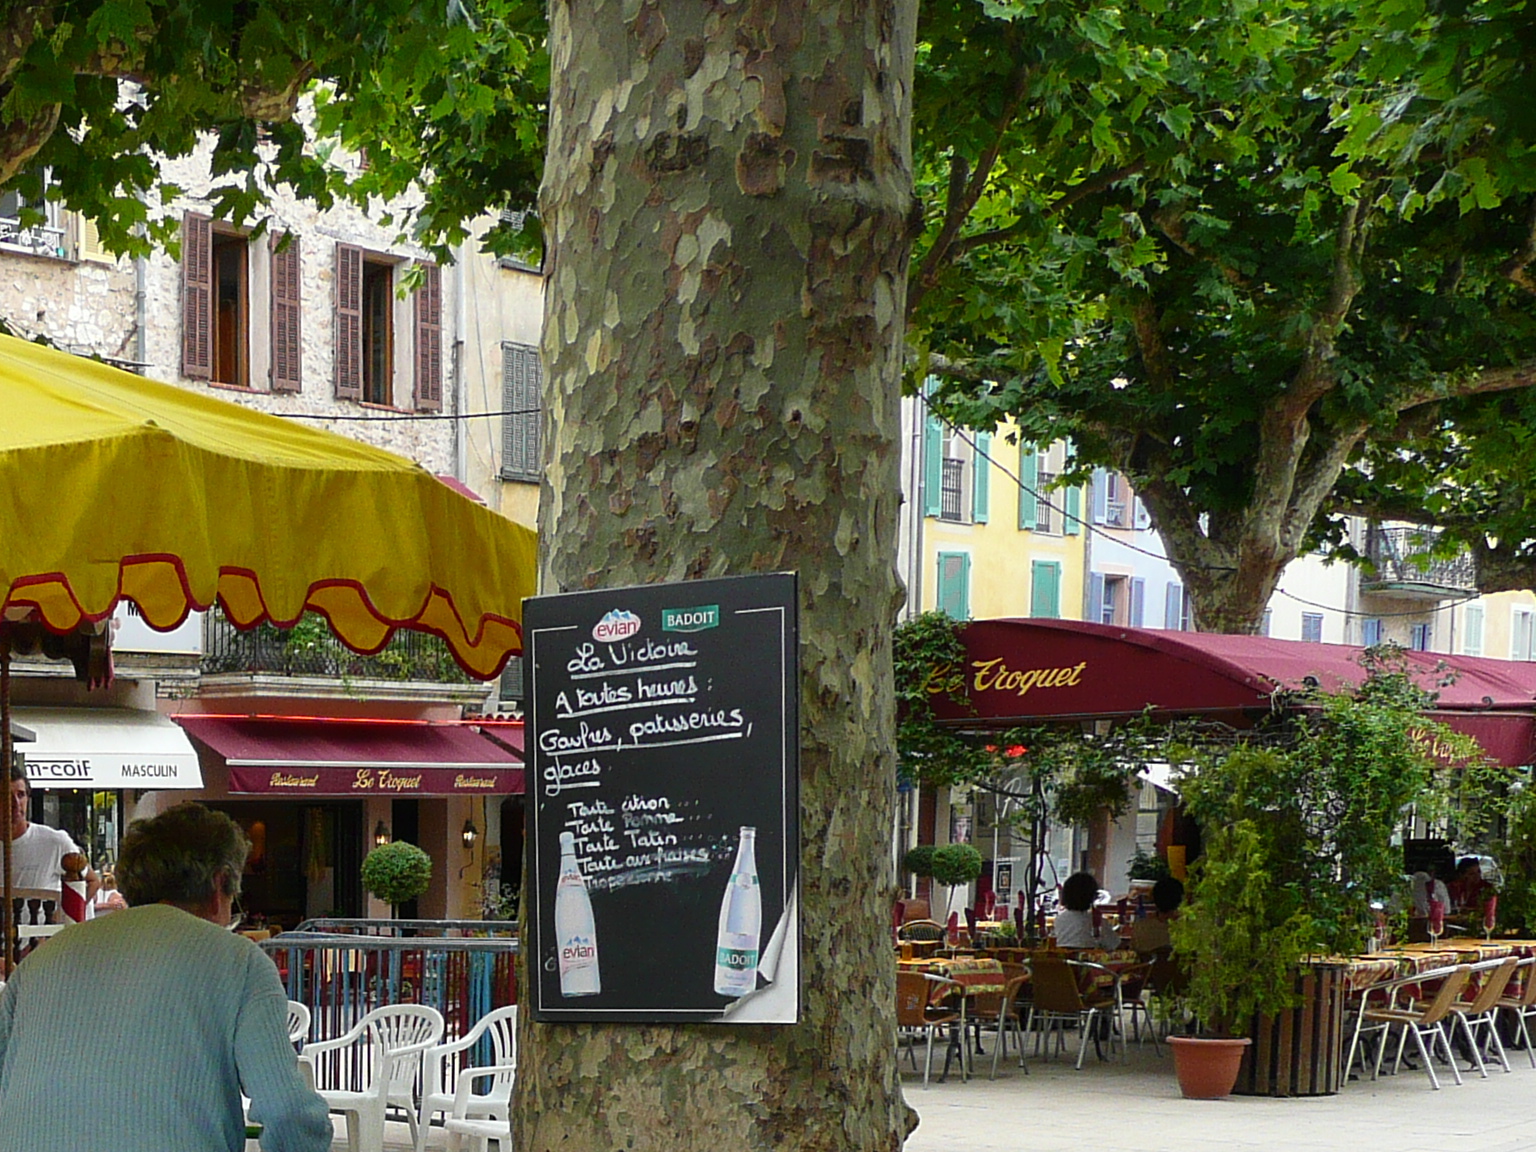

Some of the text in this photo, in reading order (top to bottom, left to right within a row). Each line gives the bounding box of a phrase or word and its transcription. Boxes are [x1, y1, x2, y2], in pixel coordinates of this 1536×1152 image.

[596, 620, 639, 638] evian
[667, 611, 715, 628] BADOIT
[566, 642, 605, 673] La
[971, 657, 1087, 697] Troquet
[555, 691, 573, 715] A
[576, 681, 633, 708] toutes
[121, 764, 178, 778] MASCULIN
[352, 768, 422, 792] Le Troquet
[623, 828, 678, 849] Tatin
[563, 944, 595, 960] evian
[719, 952, 756, 966] BADOIT
